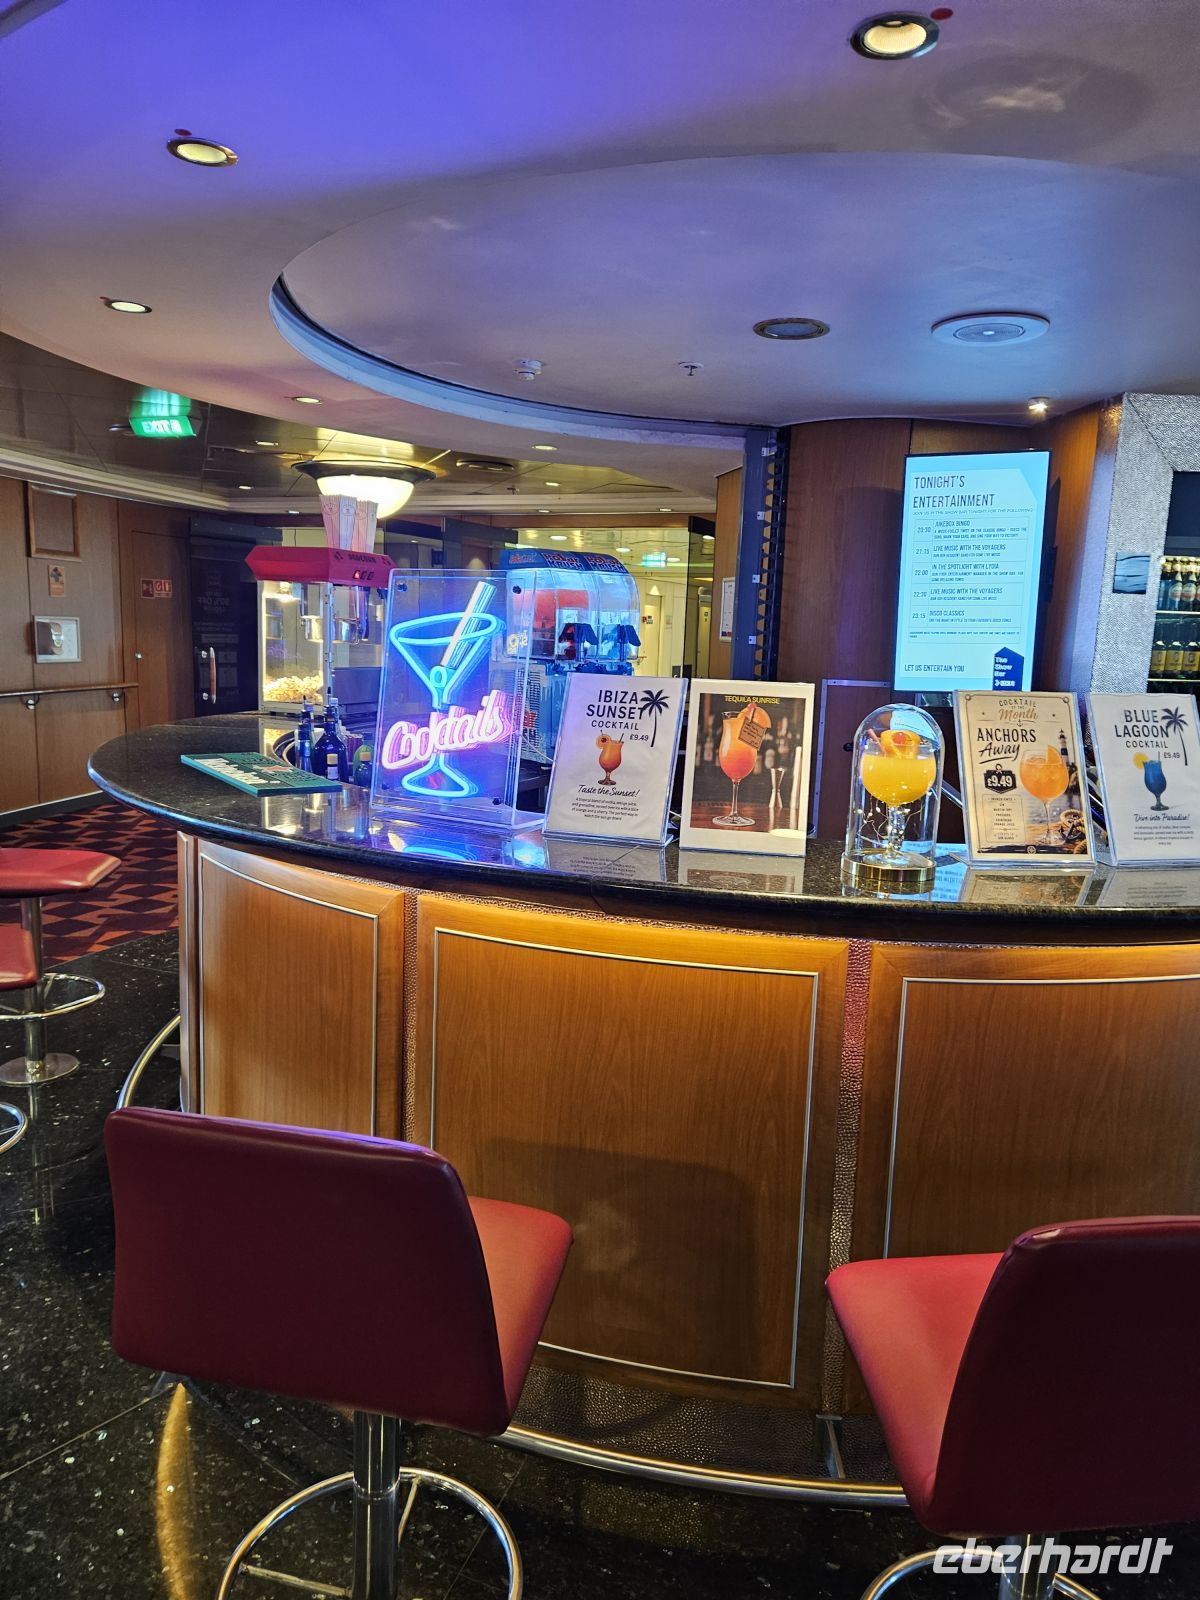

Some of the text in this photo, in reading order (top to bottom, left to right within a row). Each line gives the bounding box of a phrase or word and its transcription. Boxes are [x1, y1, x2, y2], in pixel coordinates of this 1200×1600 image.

[141, 420, 171, 433] EXIT
[914, 475, 966, 488] TONIGHT'S
[913, 494, 996, 508] ENTERTAINMENT
[598, 689, 639, 705] IBIZA
[999, 699, 1036, 707] COCKTAIL
[586, 704, 644, 720] SUNSET
[998, 708, 1038, 721] Month
[1124, 709, 1159, 723] BLUE
[382, 690, 510, 770] Cocktails
[591, 719, 640, 731] COCKTAIL
[1114, 724, 1169, 738] LAGOON
[629, 734, 649, 742] £9.49
[977, 728, 1037, 742] ANCHORS
[1125, 740, 1168, 749] COCKTAIL
[978, 742, 1020, 762] Away
[987, 774, 1013, 787] £9.49
[578, 784, 641, 798] Taste the Sunset!
[1162, 813, 1190, 821] Paradise!
